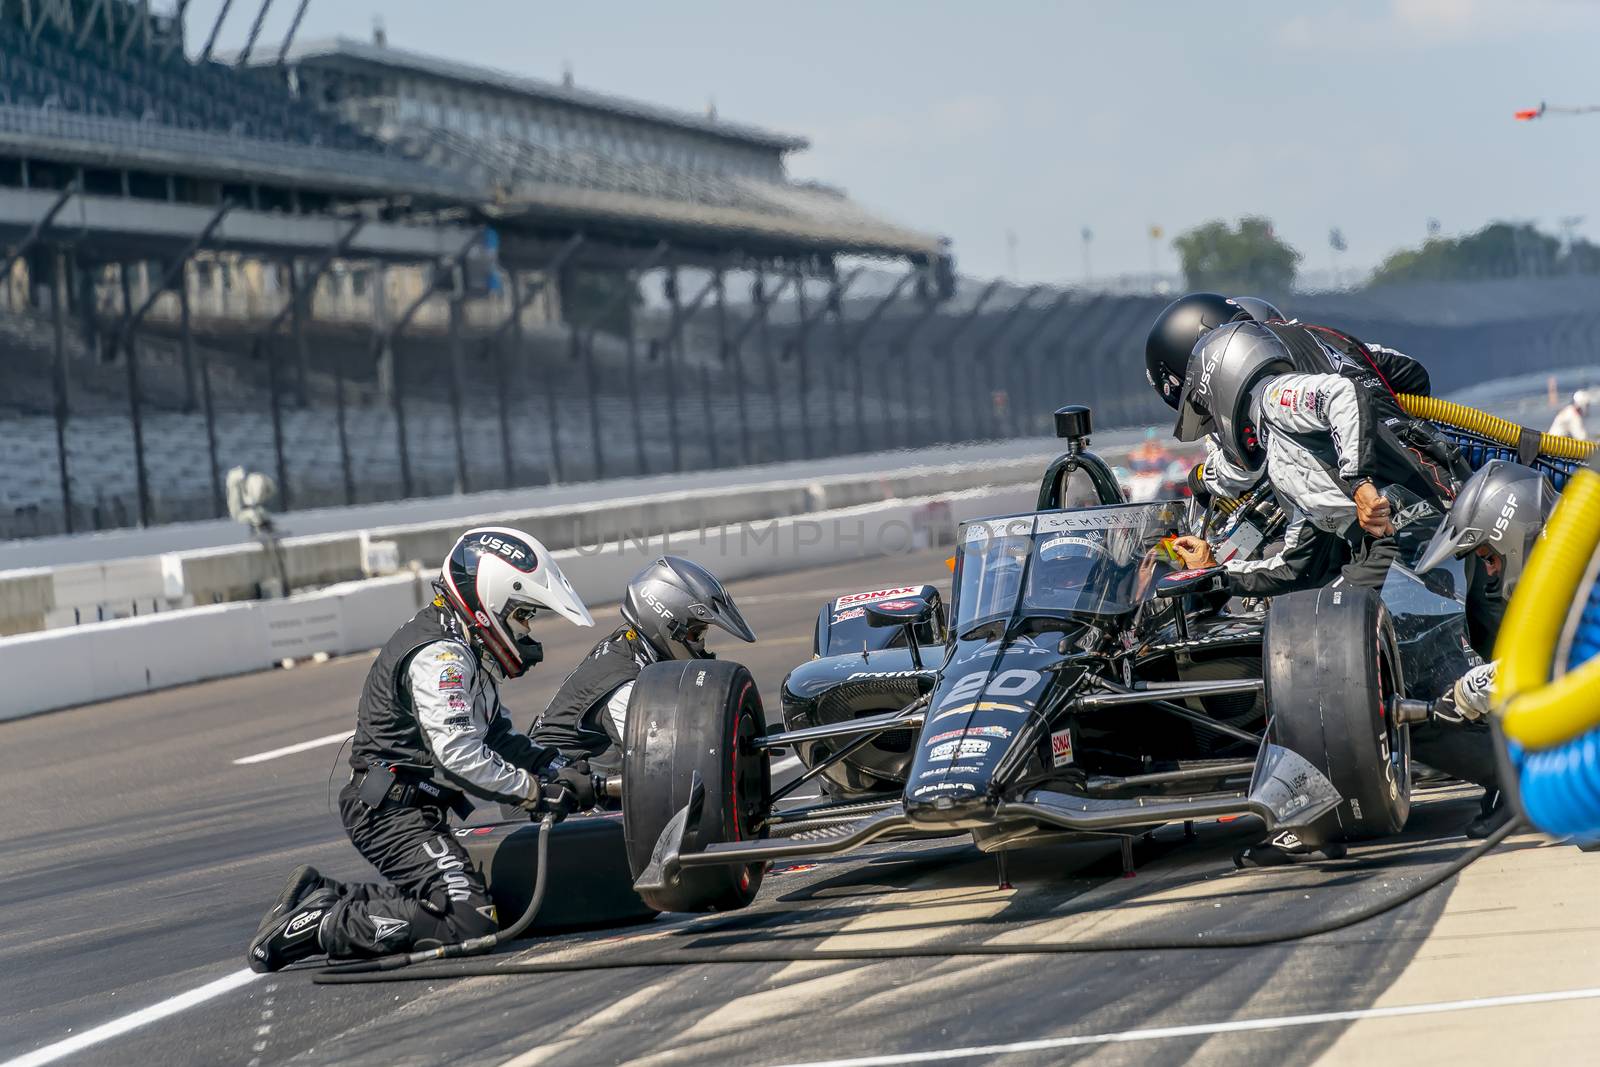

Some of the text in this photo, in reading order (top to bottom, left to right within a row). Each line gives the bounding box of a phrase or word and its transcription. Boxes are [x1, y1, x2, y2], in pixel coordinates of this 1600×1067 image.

[1199, 350, 1221, 395] USSF
[1489, 493, 1519, 541] USSF
[479, 534, 526, 560] USSF
[640, 586, 674, 619] USSF
[840, 587, 914, 604] SONAX
[937, 669, 1041, 709] 20
[1053, 735, 1070, 752] SONAX
[915, 783, 975, 796] dallara
